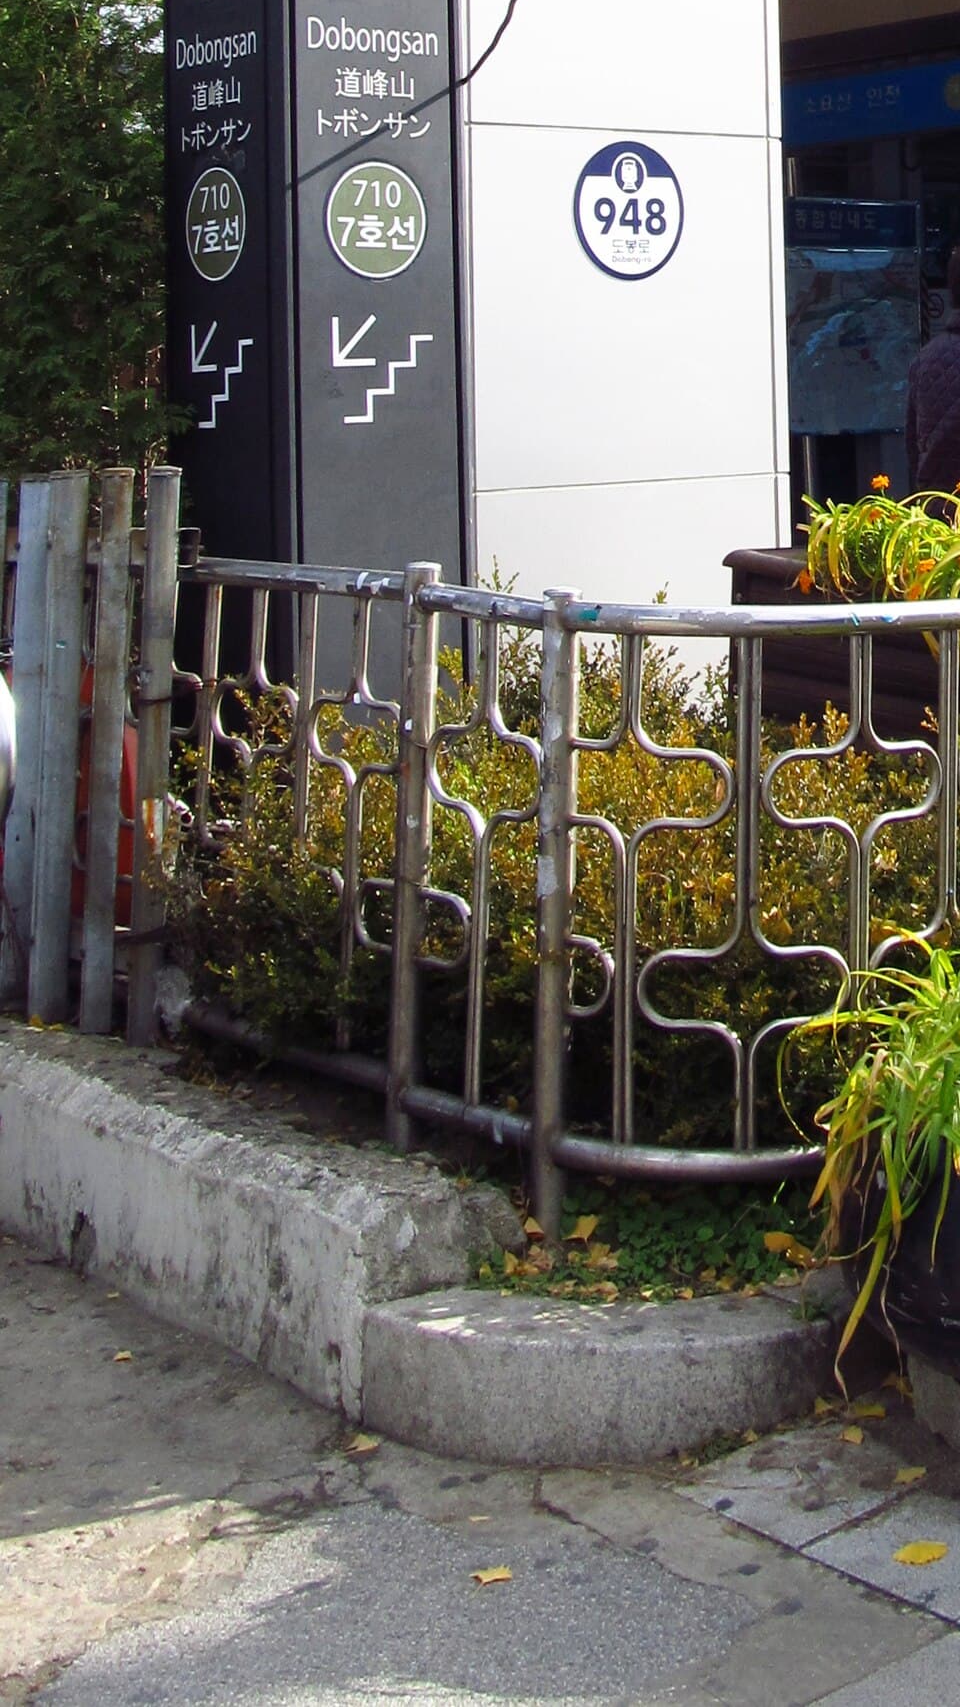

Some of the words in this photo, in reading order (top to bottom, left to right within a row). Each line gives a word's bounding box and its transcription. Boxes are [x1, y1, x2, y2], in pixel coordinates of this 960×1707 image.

[175, 27, 257, 70] Dobongsan
[307, 16, 439, 63] Dobongsan
[191, 76, 242, 112] 道峰山
[335, 67, 415, 100] 道峰山
[317, 108, 432, 140] トボンサン
[200, 182, 231, 213] 710
[352, 179, 401, 208] 710
[337, 214, 416, 251] 7호선
[593, 196, 667, 236] 948
[192, 215, 240, 254] 7호선
